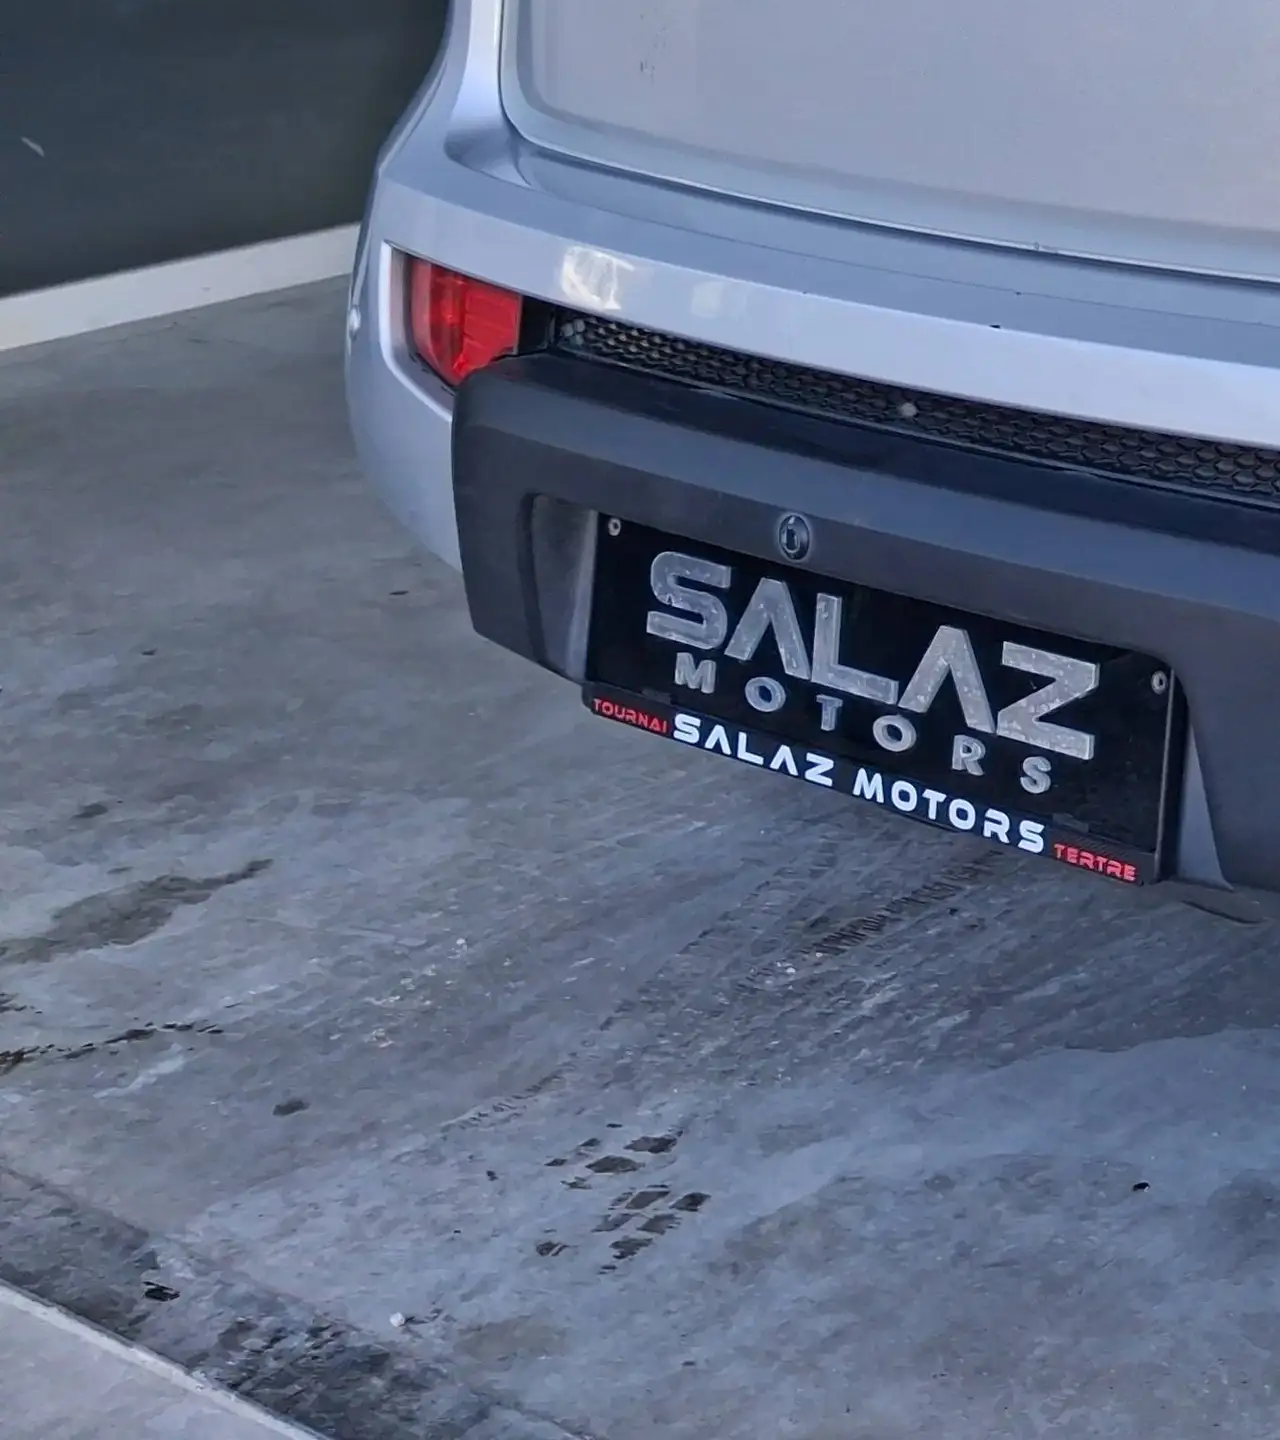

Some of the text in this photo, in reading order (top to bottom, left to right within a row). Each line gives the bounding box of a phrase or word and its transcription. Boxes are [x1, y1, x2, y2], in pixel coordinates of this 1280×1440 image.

[645, 550, 1100, 761] SALAZ
[674, 650, 1053, 795] MOTORS
[592, 697, 1138, 882] TOURNAI SALAZ MOTORS TERTRE
